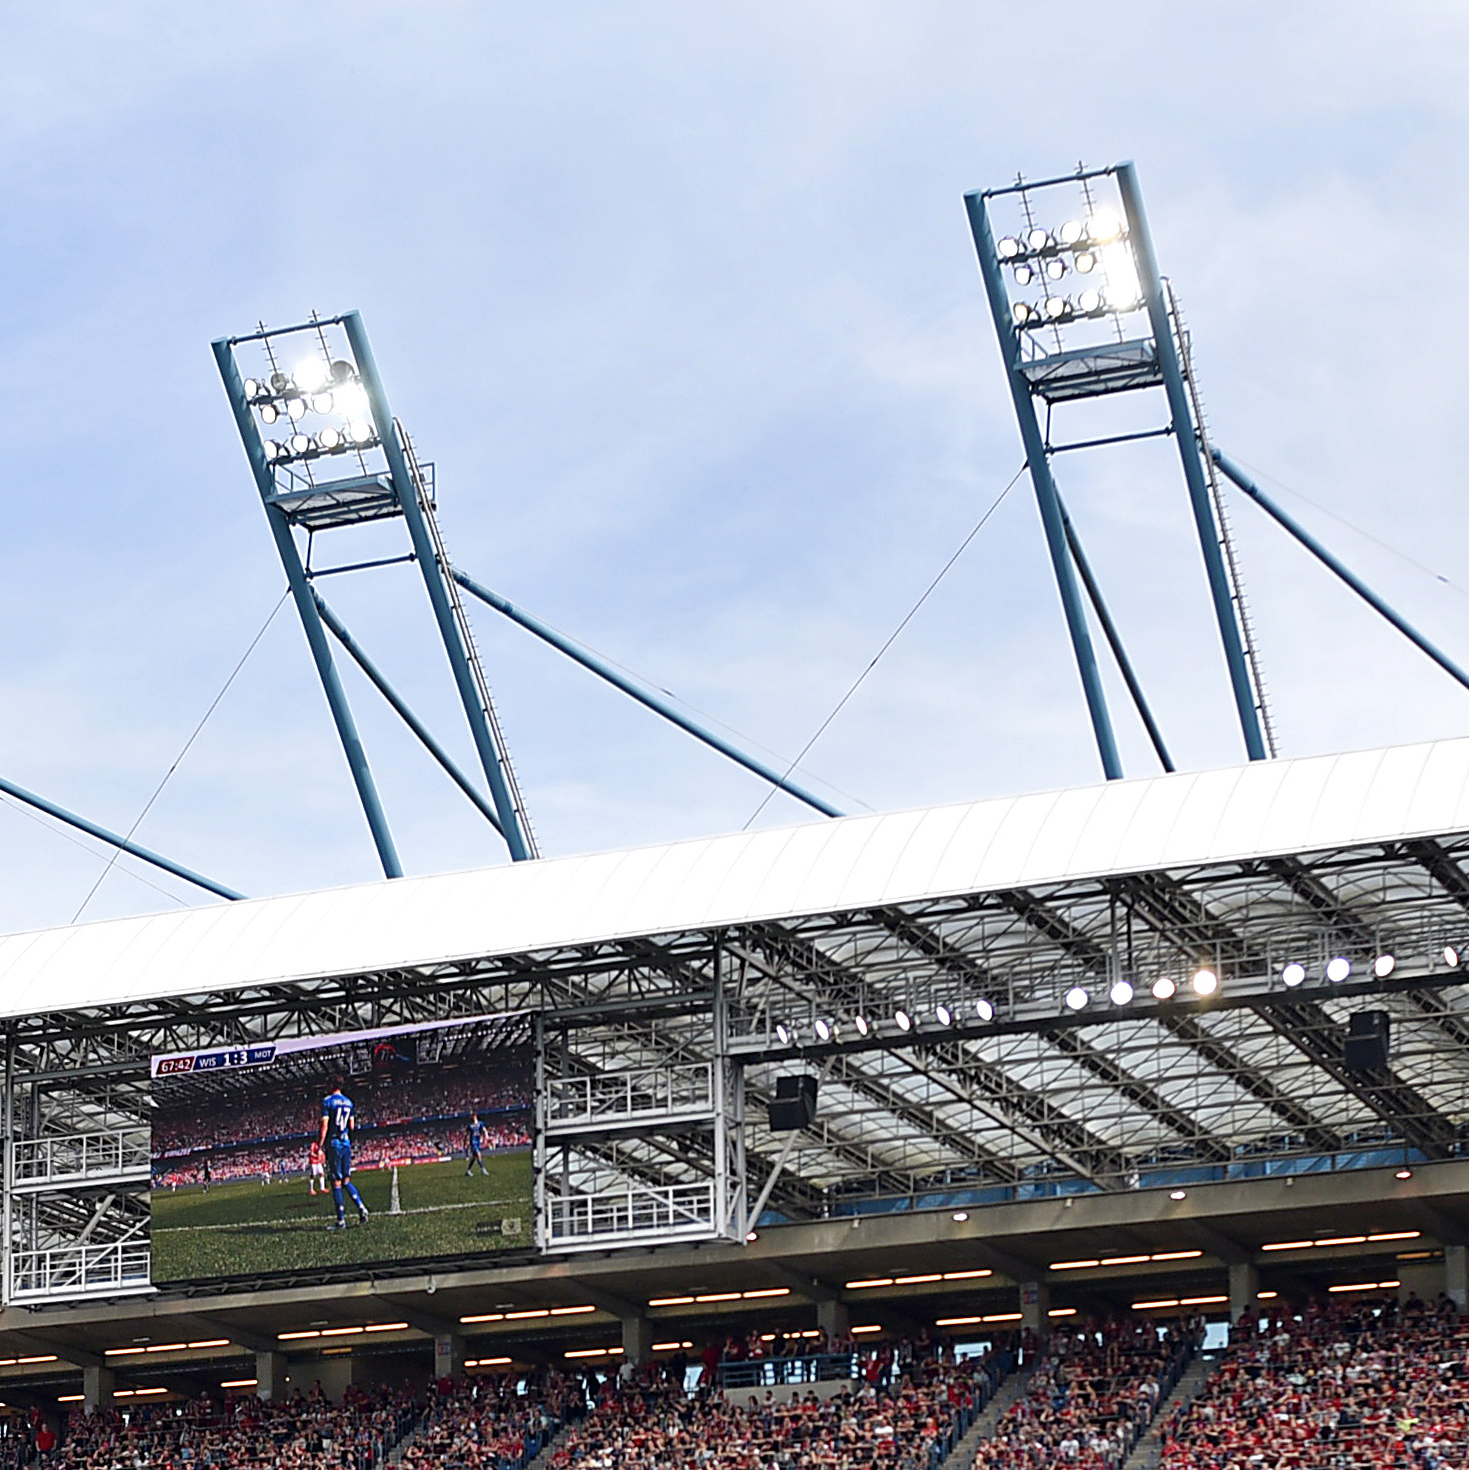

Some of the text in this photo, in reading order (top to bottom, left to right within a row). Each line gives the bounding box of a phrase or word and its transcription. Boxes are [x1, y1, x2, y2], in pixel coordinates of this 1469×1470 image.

[161, 1059, 191, 1073] 67:42
[199, 1057, 217, 1069] WIS
[254, 1050, 272, 1060] MOT
